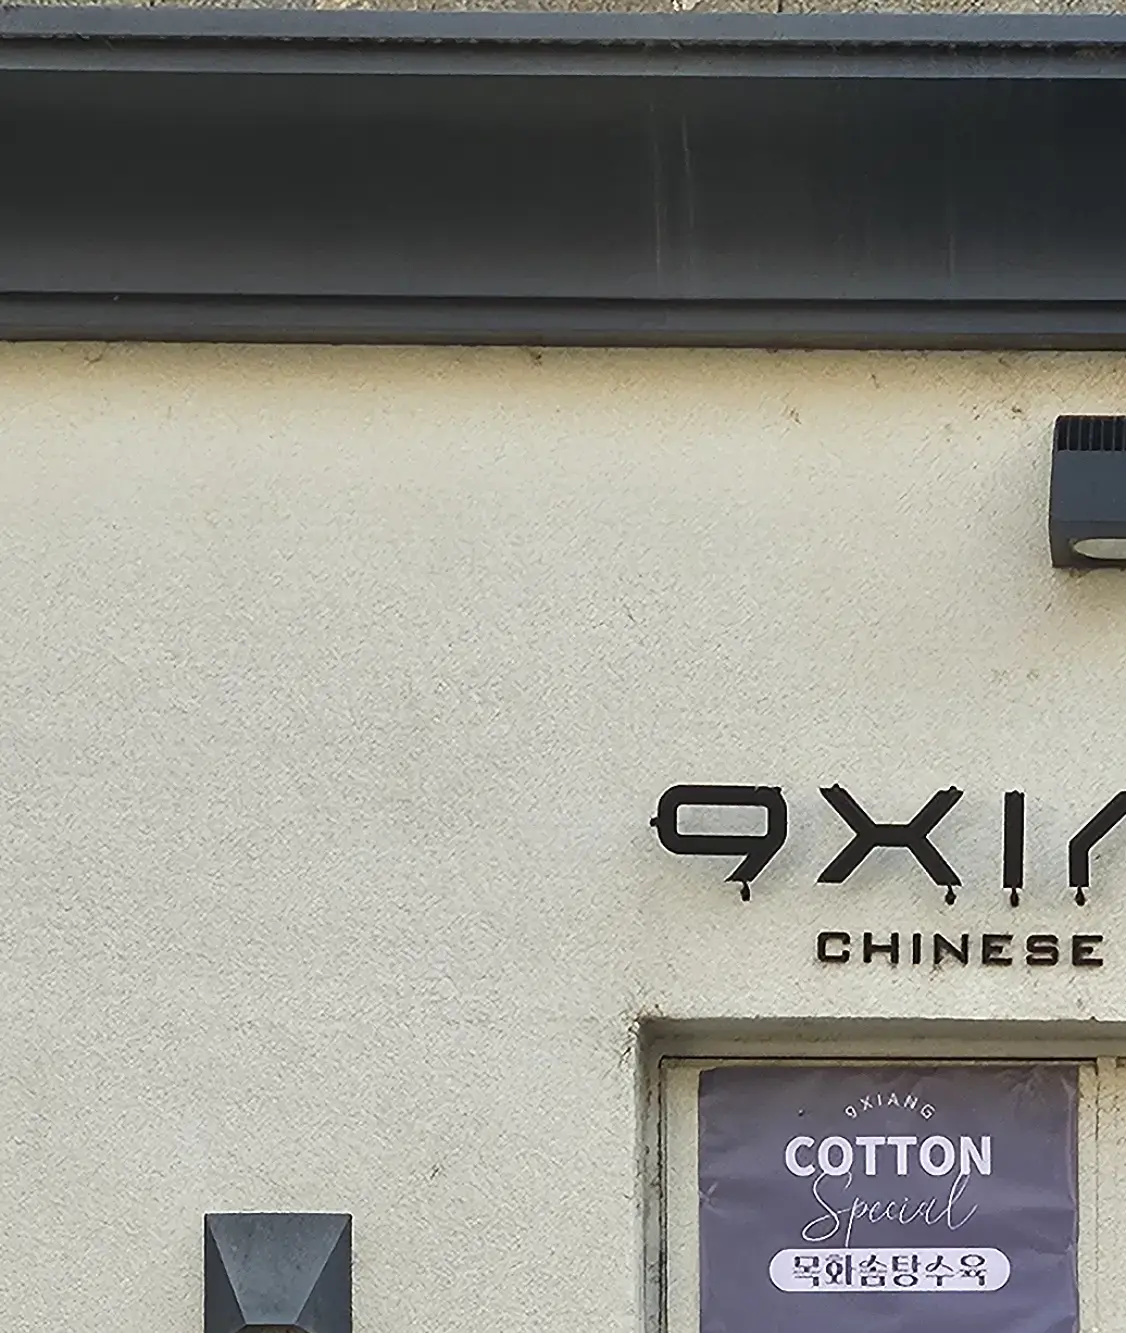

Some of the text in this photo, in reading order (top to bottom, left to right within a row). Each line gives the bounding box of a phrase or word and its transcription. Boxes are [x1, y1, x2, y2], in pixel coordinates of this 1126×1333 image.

[815, 931, 1105, 968] CHINESE
[784, 1134, 993, 1177] COTTON
[801, 1170, 979, 1247] Special
[793, 1253, 988, 1288] 목화솜탕수육
